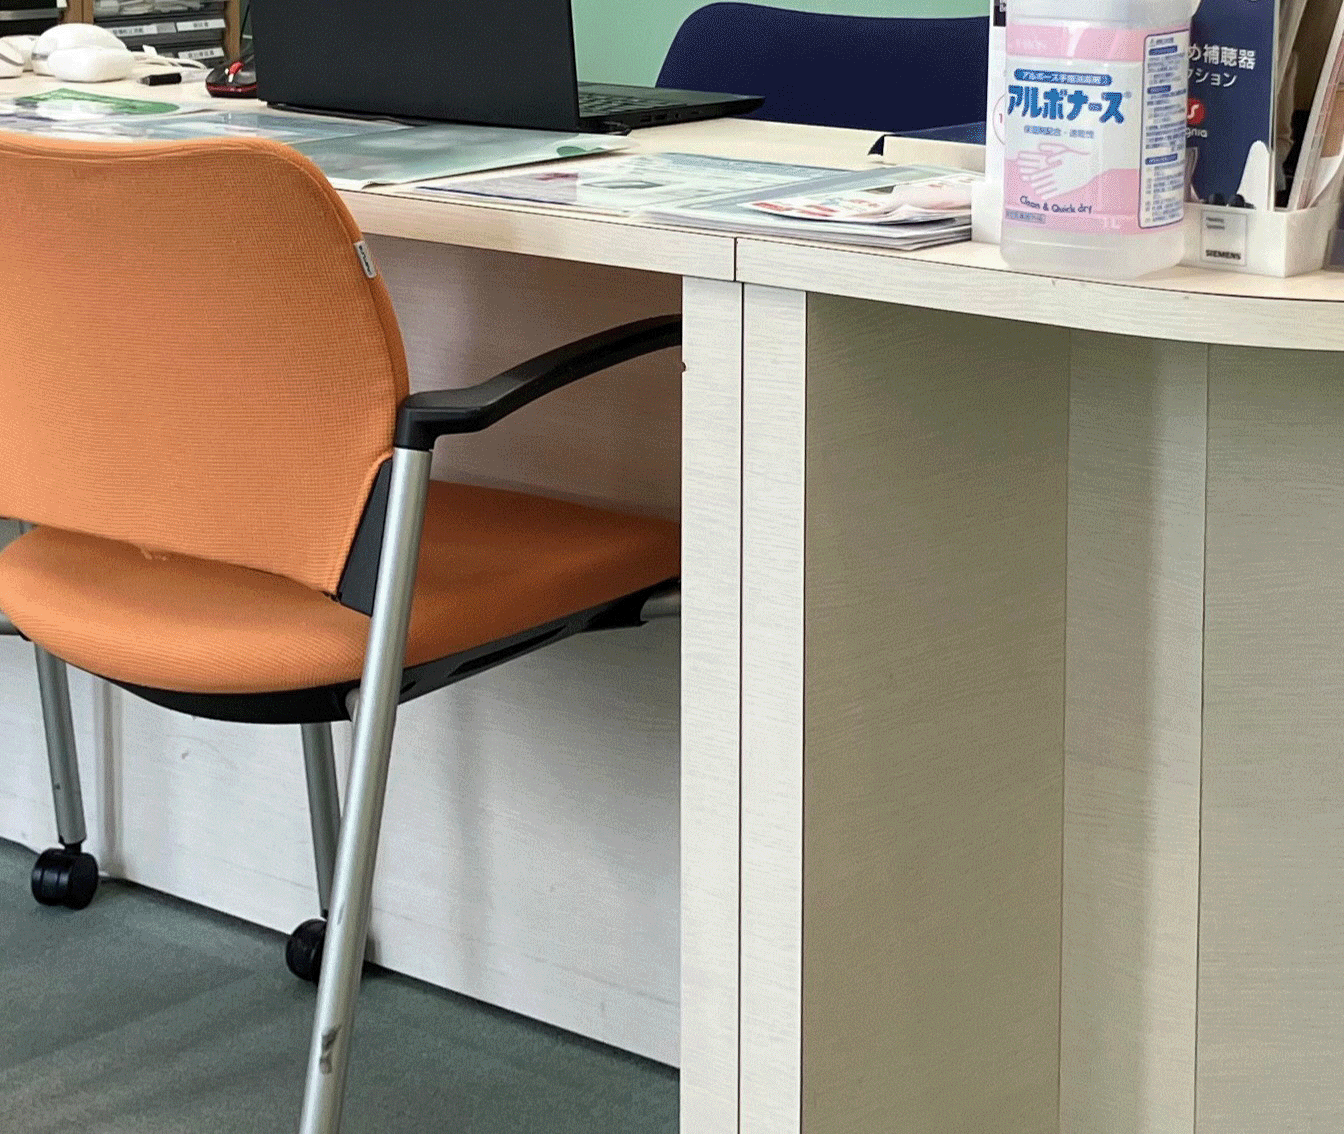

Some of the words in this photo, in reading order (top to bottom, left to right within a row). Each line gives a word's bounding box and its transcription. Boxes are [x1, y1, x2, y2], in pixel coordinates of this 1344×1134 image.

[1007, 84, 1125, 124] アルボナース
[1185, 127, 1207, 138] gnia
[1019, 195, 1041, 210] Clean
[1051, 203, 1076, 213] Quick
[1077, 203, 1092, 214] dry
[1205, 249, 1242, 260] SIEMENS
